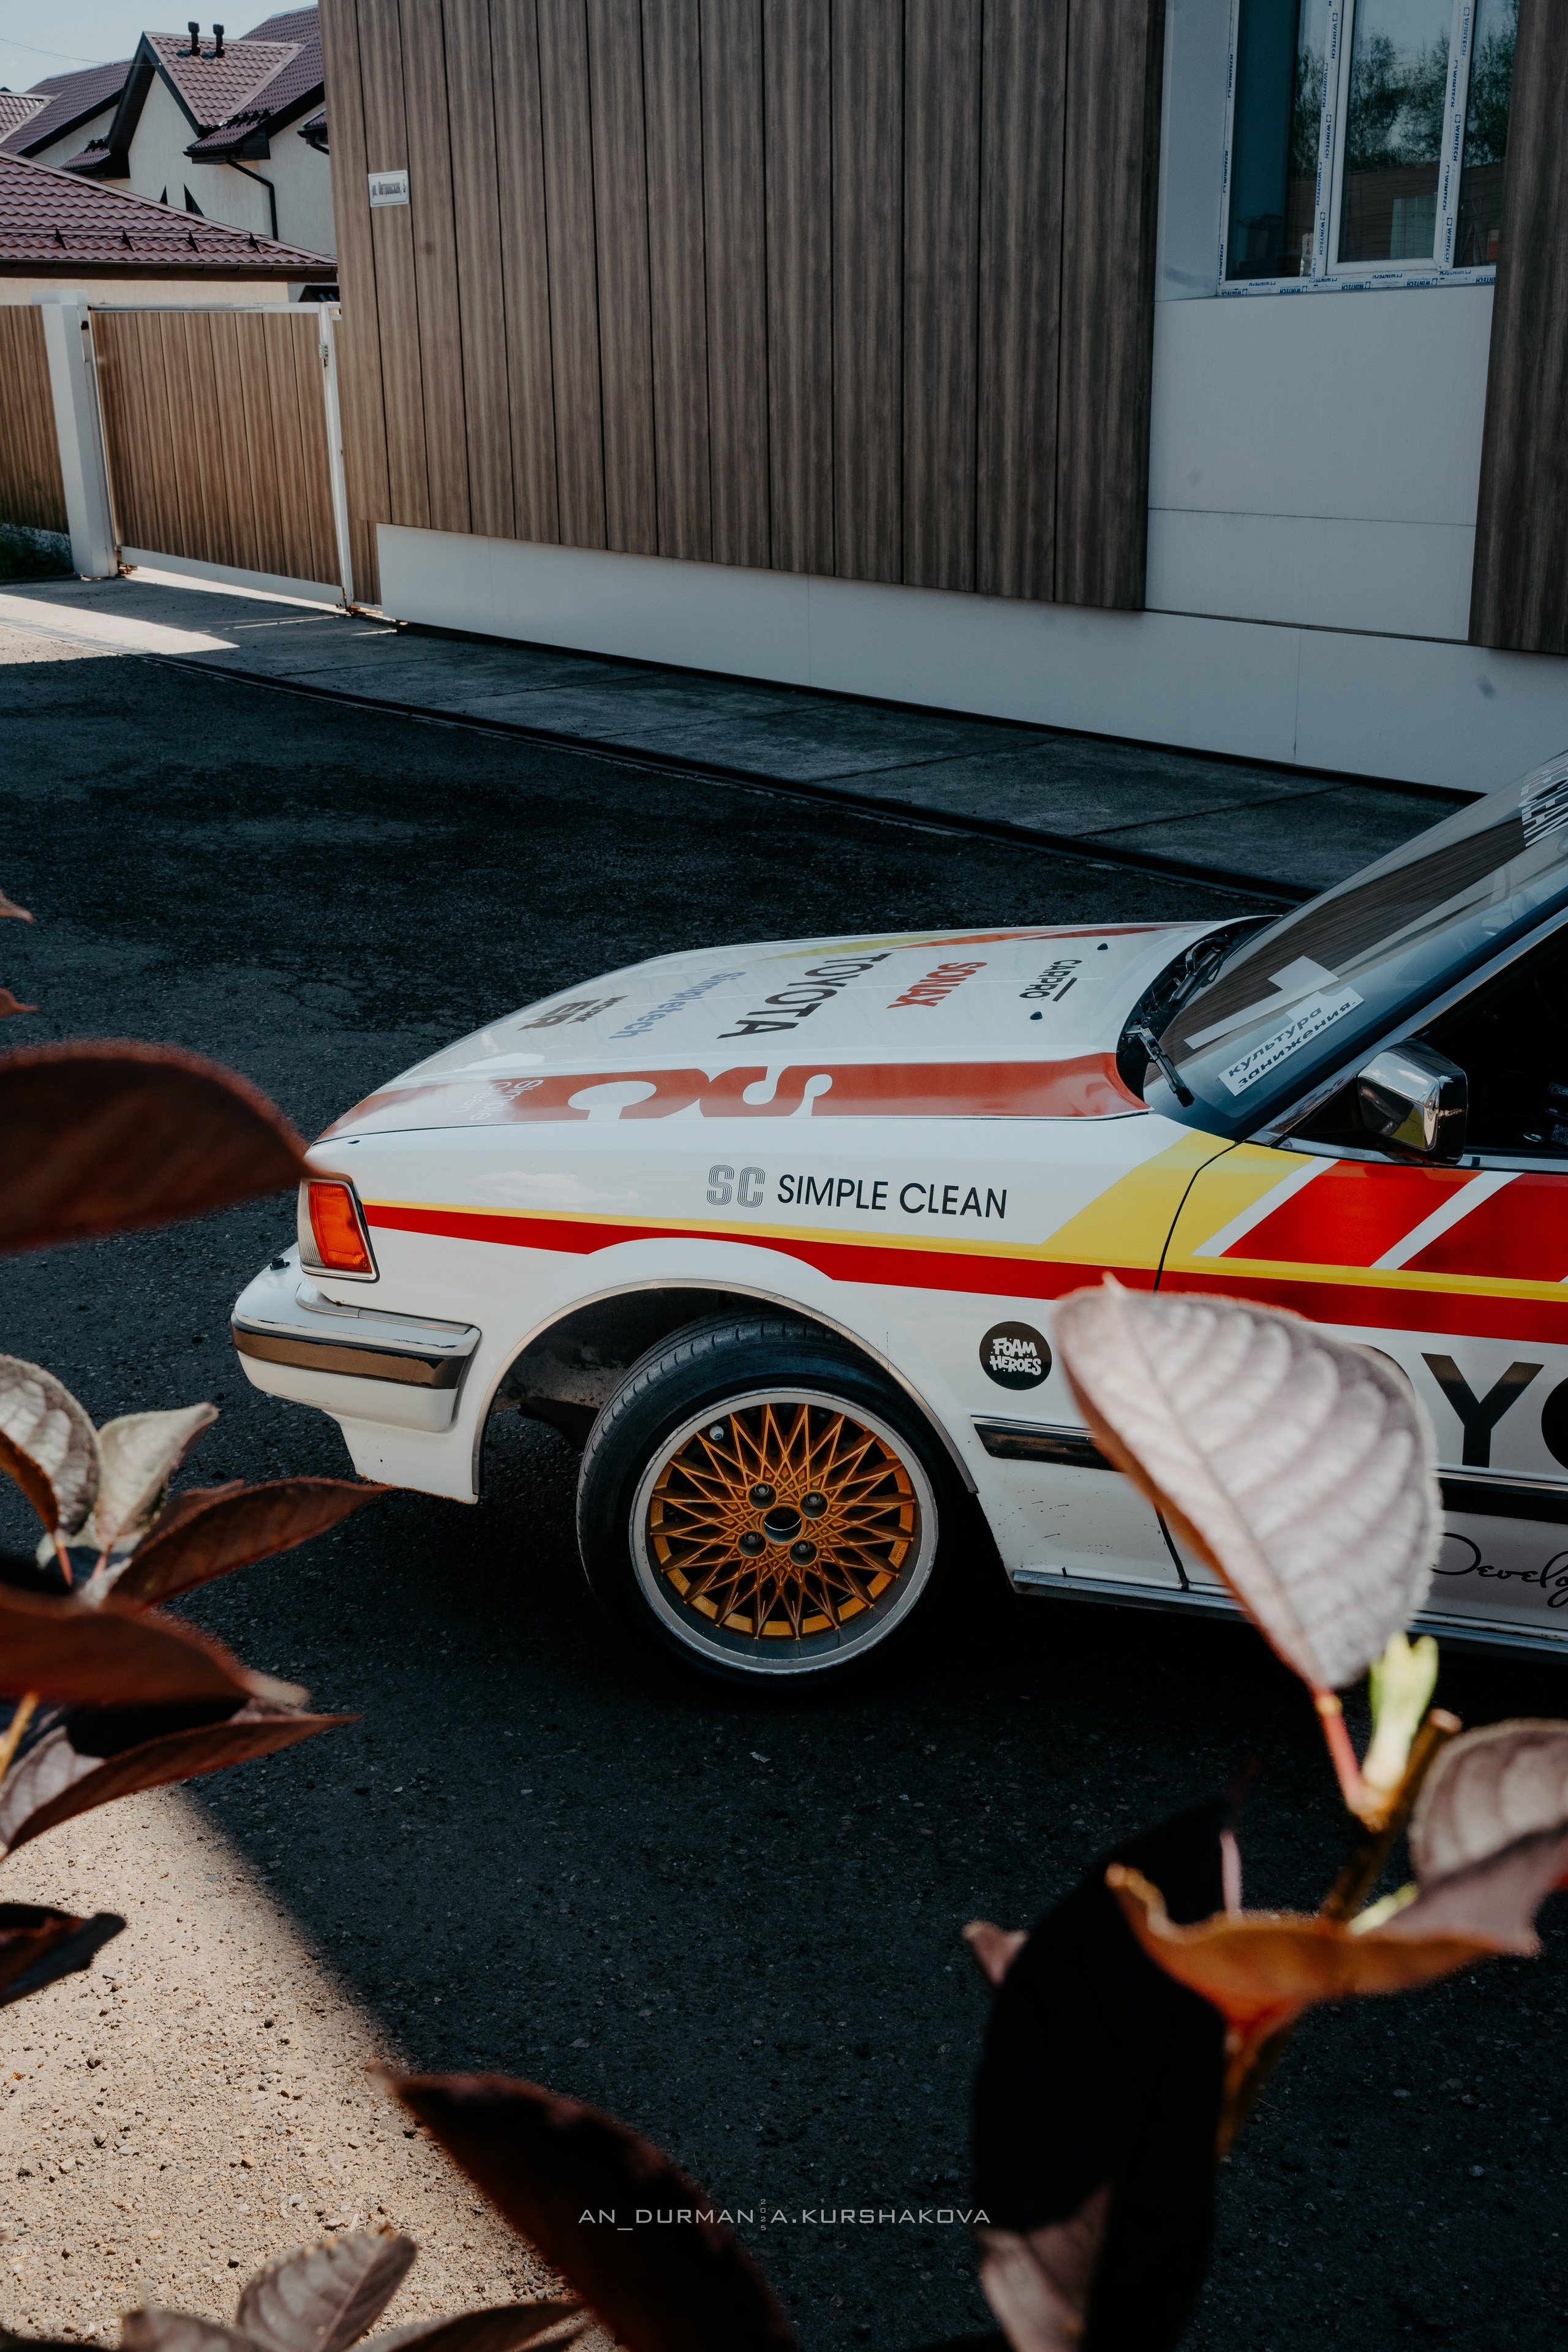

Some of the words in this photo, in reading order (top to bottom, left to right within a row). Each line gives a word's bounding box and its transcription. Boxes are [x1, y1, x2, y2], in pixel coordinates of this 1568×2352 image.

[716, 952, 894, 1039] TOYOTA
[886, 962, 988, 1009] SONAX
[1019, 960, 1083, 999] CARPRO
[608, 971, 747, 1039] Simpletech
[1229, 1007, 1322, 1077] культура
[1238, 1001, 1357, 1088] занижения.
[451, 1082, 512, 1113] Clean
[469, 1079, 544, 1121] Simple
[707, 1164, 766, 1208] SC
[777, 1174, 889, 1210] SIMPLE
[899, 1183, 1008, 1219] CLEAN
[989, 1355, 1041, 1376] HEROES
[993, 1337, 1038, 1357] FOAM
